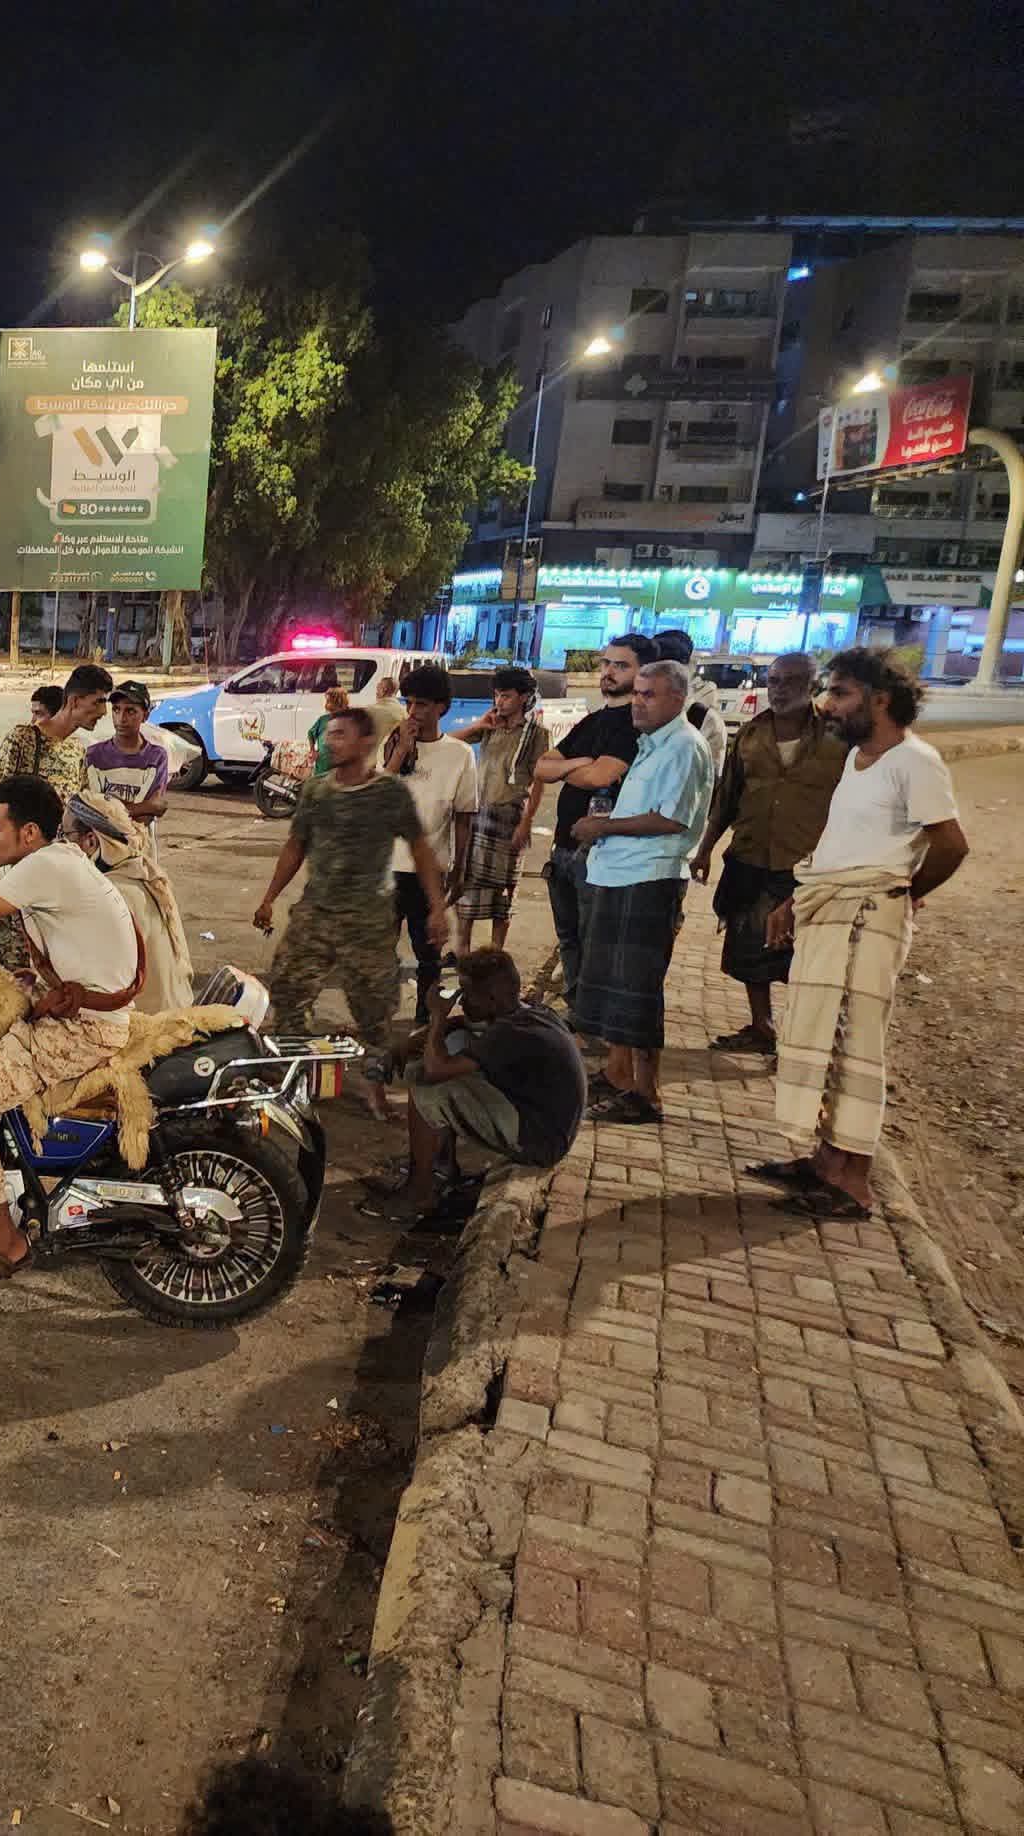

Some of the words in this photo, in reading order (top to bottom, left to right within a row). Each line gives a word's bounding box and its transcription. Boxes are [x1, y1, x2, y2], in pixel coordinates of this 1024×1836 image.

[82, 360, 135, 374] استلمها
[71, 376, 102, 391] مكان
[127, 377, 144, 391] من
[72, 468, 136, 484] الوسيط
[77, 535, 89, 544] عبر
[126, 535, 149, 544] متاحة
[75, 545, 91, 555] في
[121, 544, 154, 556] الموحدة
[154, 544, 184, 556] الشبكة
